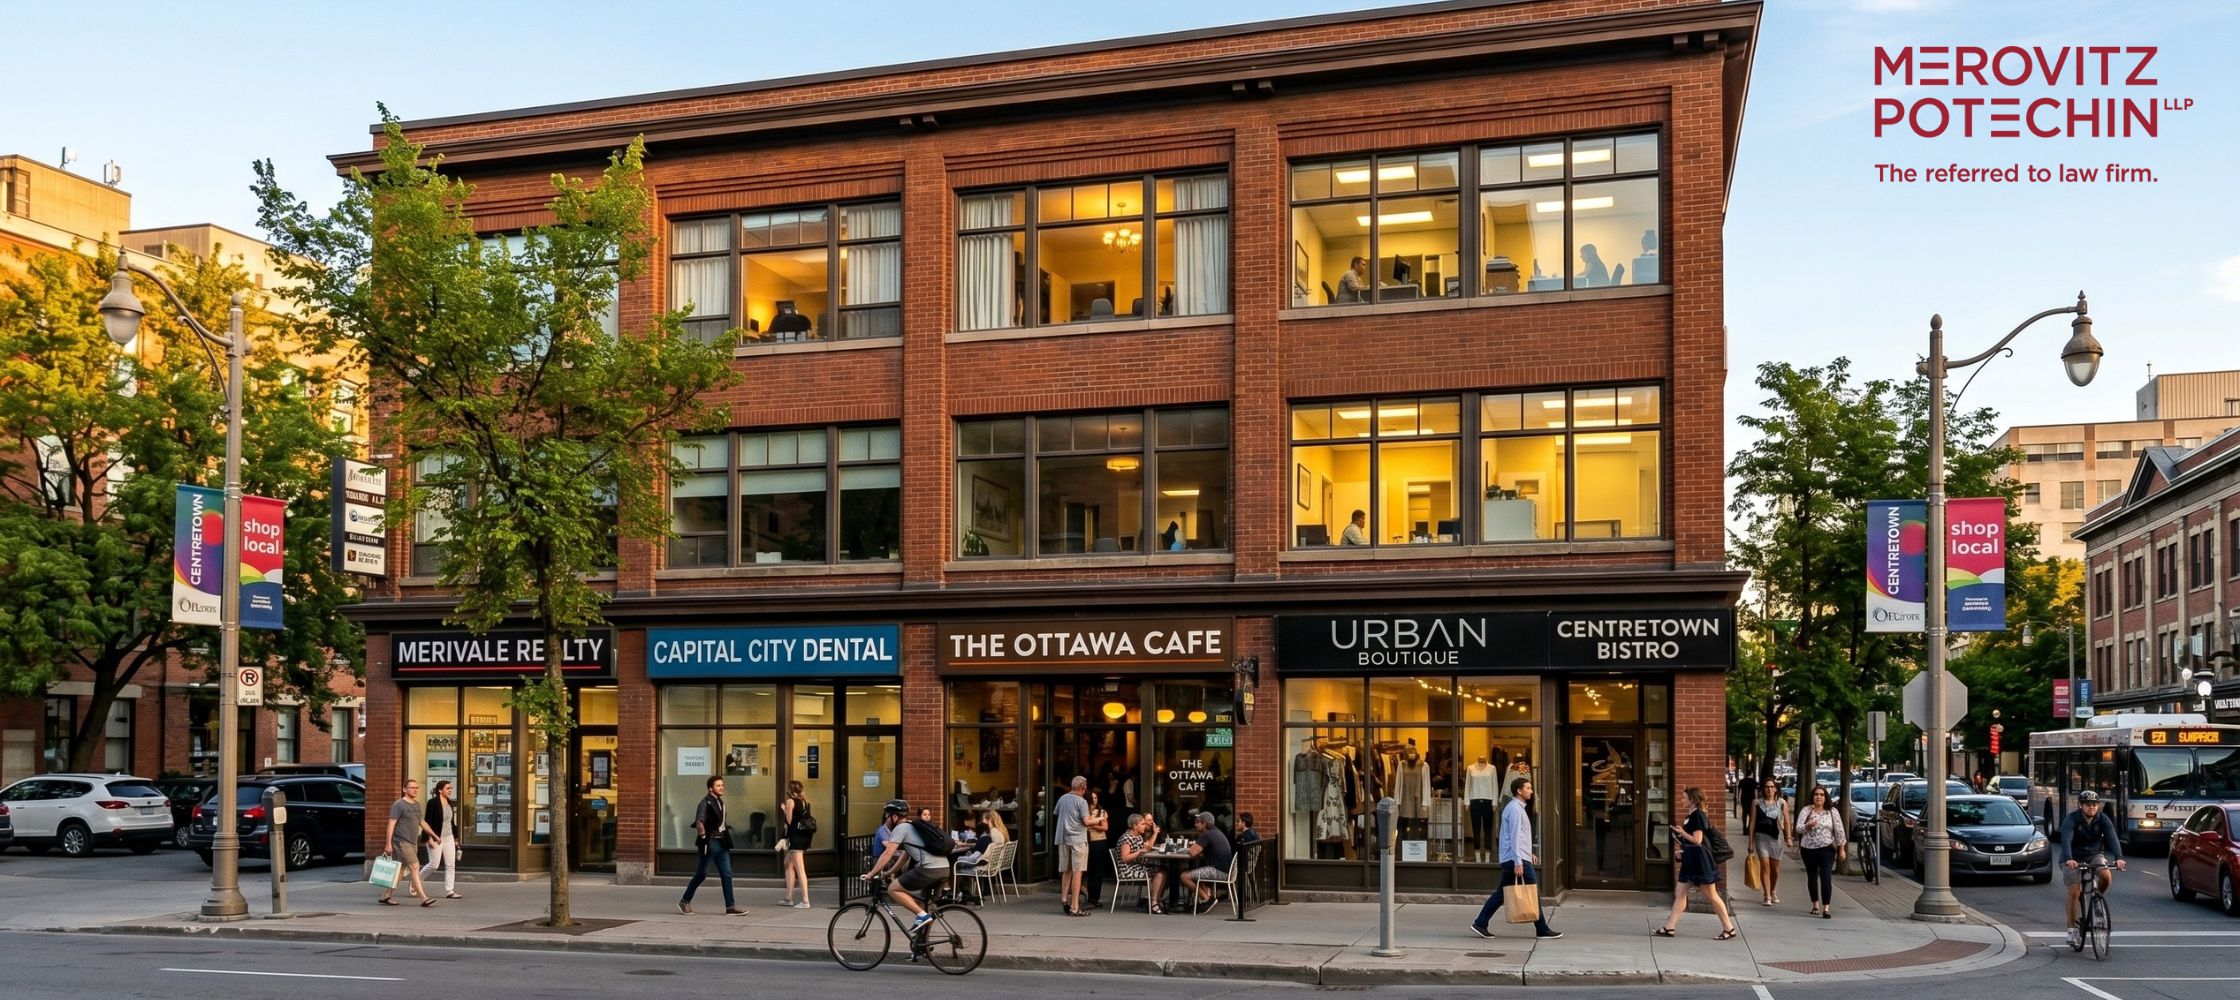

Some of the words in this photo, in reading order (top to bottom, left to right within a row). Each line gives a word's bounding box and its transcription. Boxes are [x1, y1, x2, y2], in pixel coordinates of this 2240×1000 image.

[244, 518, 280, 537] shop
[1951, 520, 1999, 538] shop
[191, 493, 203, 585] CENTRETOWN
[244, 536, 280, 555] local
[1952, 539, 1998, 555] local
[1888, 506, 1900, 595] CENTRETOWN
[1331, 617, 1486, 649] URBAN
[1557, 618, 1719, 638] CENTRETOWN
[398, 639, 509, 663] MERIVALE
[517, 638, 604, 662] RELTY
[654, 640, 742, 664] CAPITAL
[749, 639, 797, 662] CITY
[803, 637, 893, 661] DENTAL
[950, 634, 1005, 658] THE
[1014, 631, 1136, 657] OTTAWA
[1143, 630, 1221, 655] CAFE
[1597, 641, 1679, 660] BISTRO
[1358, 650, 1459, 667] BOUTIQUE
[1180, 759, 1203, 769] THE
[1169, 770, 1214, 780] OTTAWA
[1178, 781, 1206, 792] CAFE
